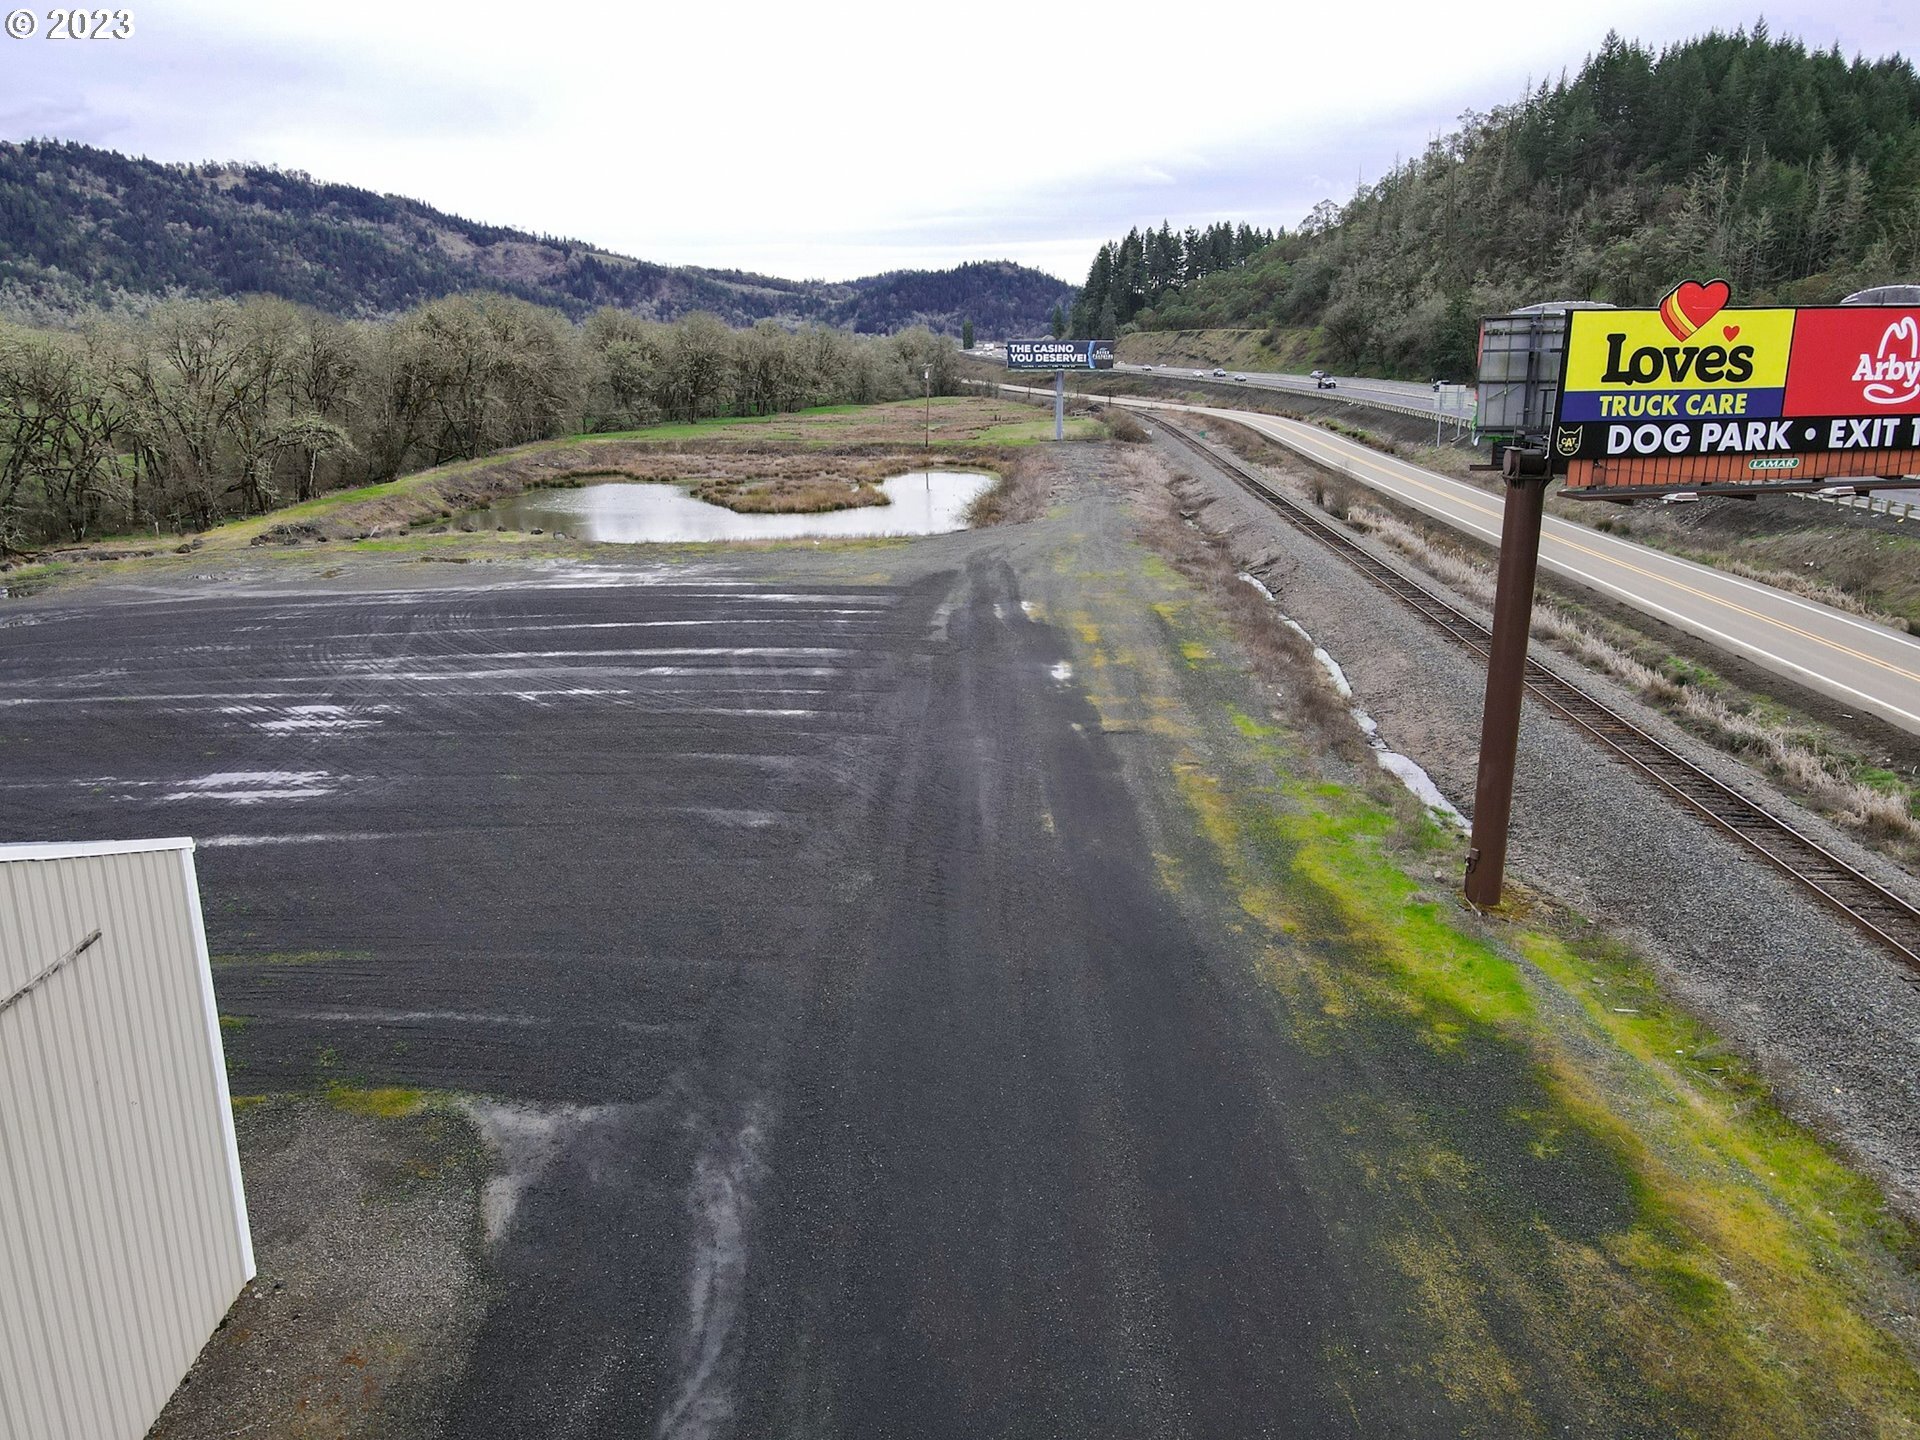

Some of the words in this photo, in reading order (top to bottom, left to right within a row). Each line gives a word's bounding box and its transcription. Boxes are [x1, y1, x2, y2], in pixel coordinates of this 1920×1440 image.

[1010, 345, 1031, 353] THE
[1033, 344, 1074, 353] CASINO
[1011, 353, 1033, 363] YOU
[1035, 353, 1087, 363] DESERVE!
[1599, 395, 1680, 417] TRUCK
[1685, 393, 1748, 415] CARE
[1607, 423, 1691, 454] DOG
[1700, 420, 1793, 452] PARK
[1828, 418, 1901, 449] EXIT
[1561, 437, 1577, 447] CAT
[1753, 460, 1795, 468] LAMAR
